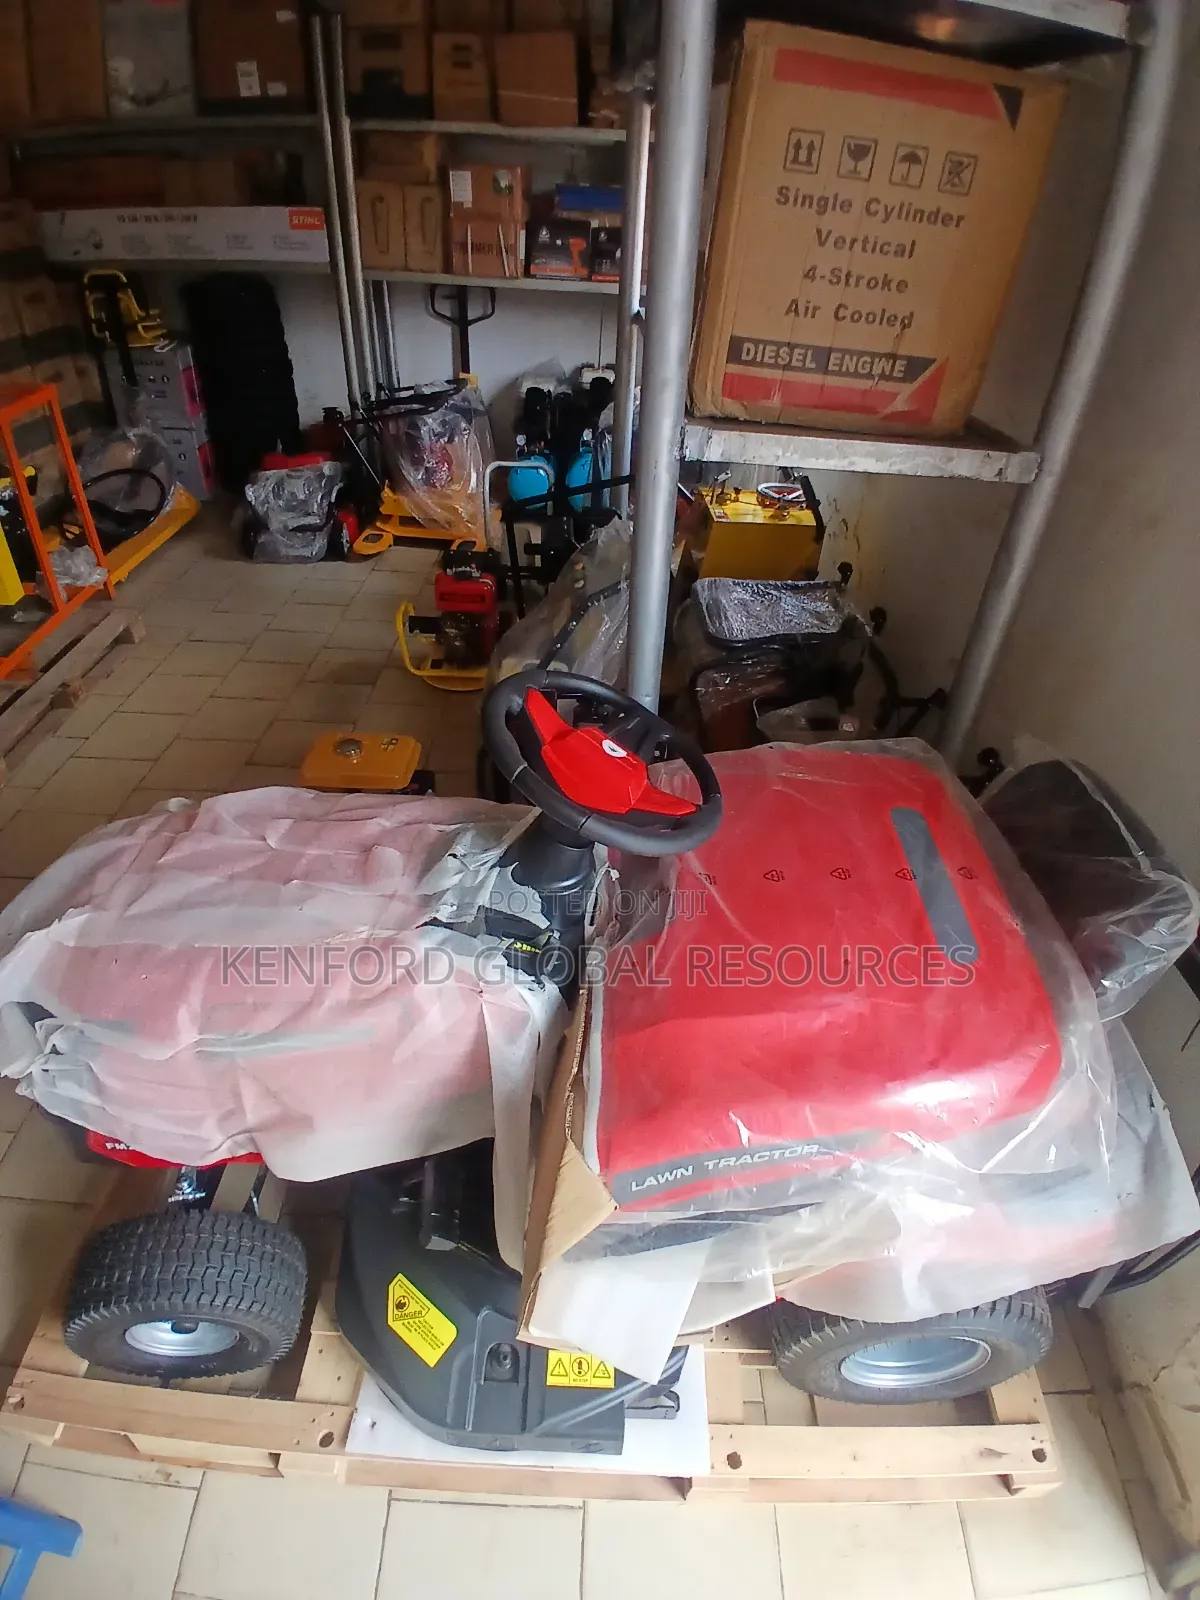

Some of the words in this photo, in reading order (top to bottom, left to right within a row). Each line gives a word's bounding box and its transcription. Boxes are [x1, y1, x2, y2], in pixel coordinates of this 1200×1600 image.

[291, 215, 321, 225] STIHL
[775, 185, 853, 216] Single
[864, 197, 966, 228] Cylinder
[815, 227, 916, 259] Vertical
[803, 264, 909, 294] 4-Stroke
[784, 298, 821, 319] Air
[833, 303, 915, 331] Cooled
[741, 342, 816, 369] DIESEL
[827, 352, 908, 378] ENGINE
[105, 1142, 133, 1151] FM
[631, 1165, 694, 1192] LAWN
[704, 1144, 820, 1171] TRACTOR
[394, 1310, 423, 1320] DANGER
